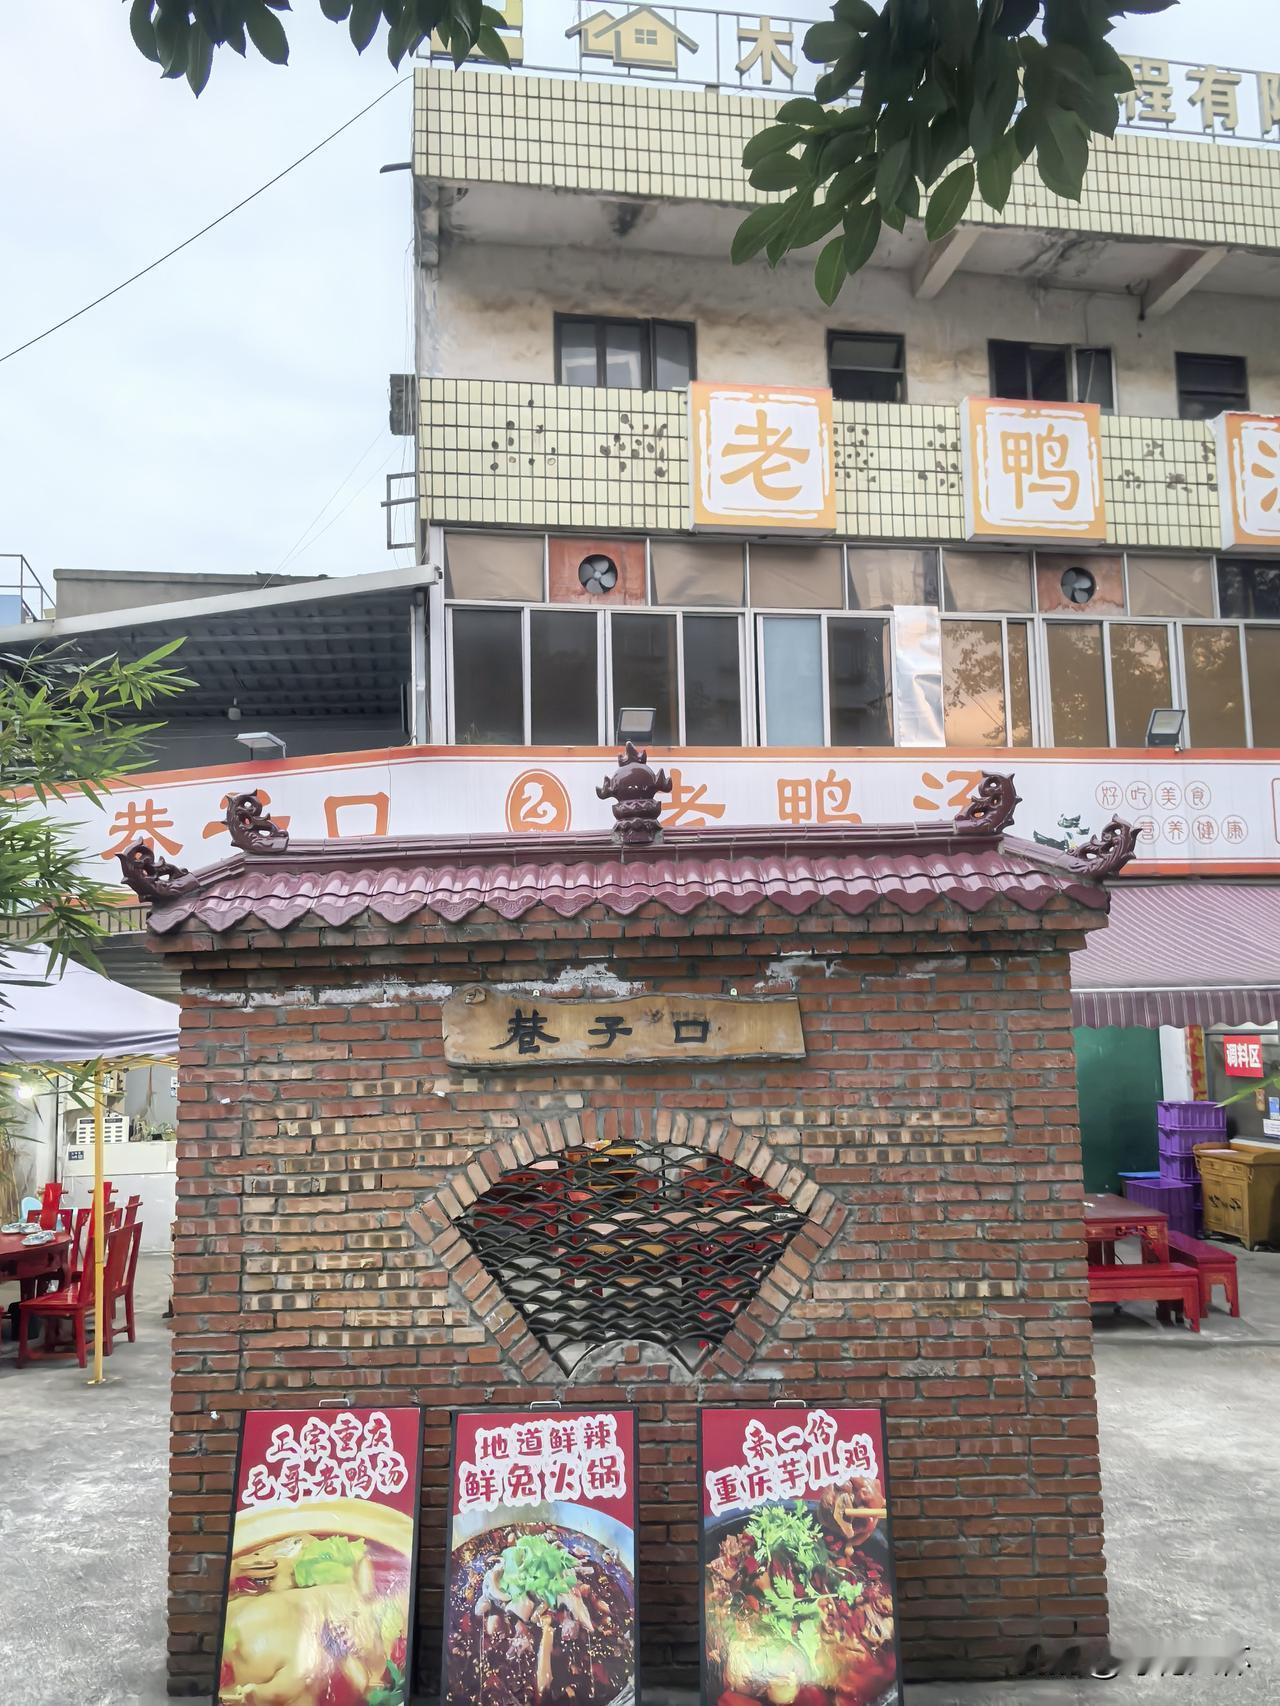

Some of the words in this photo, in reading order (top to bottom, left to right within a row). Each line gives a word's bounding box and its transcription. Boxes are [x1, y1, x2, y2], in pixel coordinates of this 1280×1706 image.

[735, 15, 799, 85] 木
[720, 409, 810, 501] 老
[1000, 423, 1081, 511] 鸭
[1100, 785, 1207, 807] 好吃美食
[1139, 820, 1243, 841] 营养健康
[490, 1008, 710, 1055] 巷子口
[1225, 1042, 1263, 1069] 调料区
[269, 1416, 391, 1457] 正宗重庆
[479, 1420, 612, 1460] 地道鲜辣
[746, 1415, 834, 1461] 来一份
[247, 1456, 406, 1503] 毛哥老鸭汤
[464, 1454, 622, 1504] 鲜兔火锅
[714, 1441, 872, 1506] 重庆芋儿鸡
